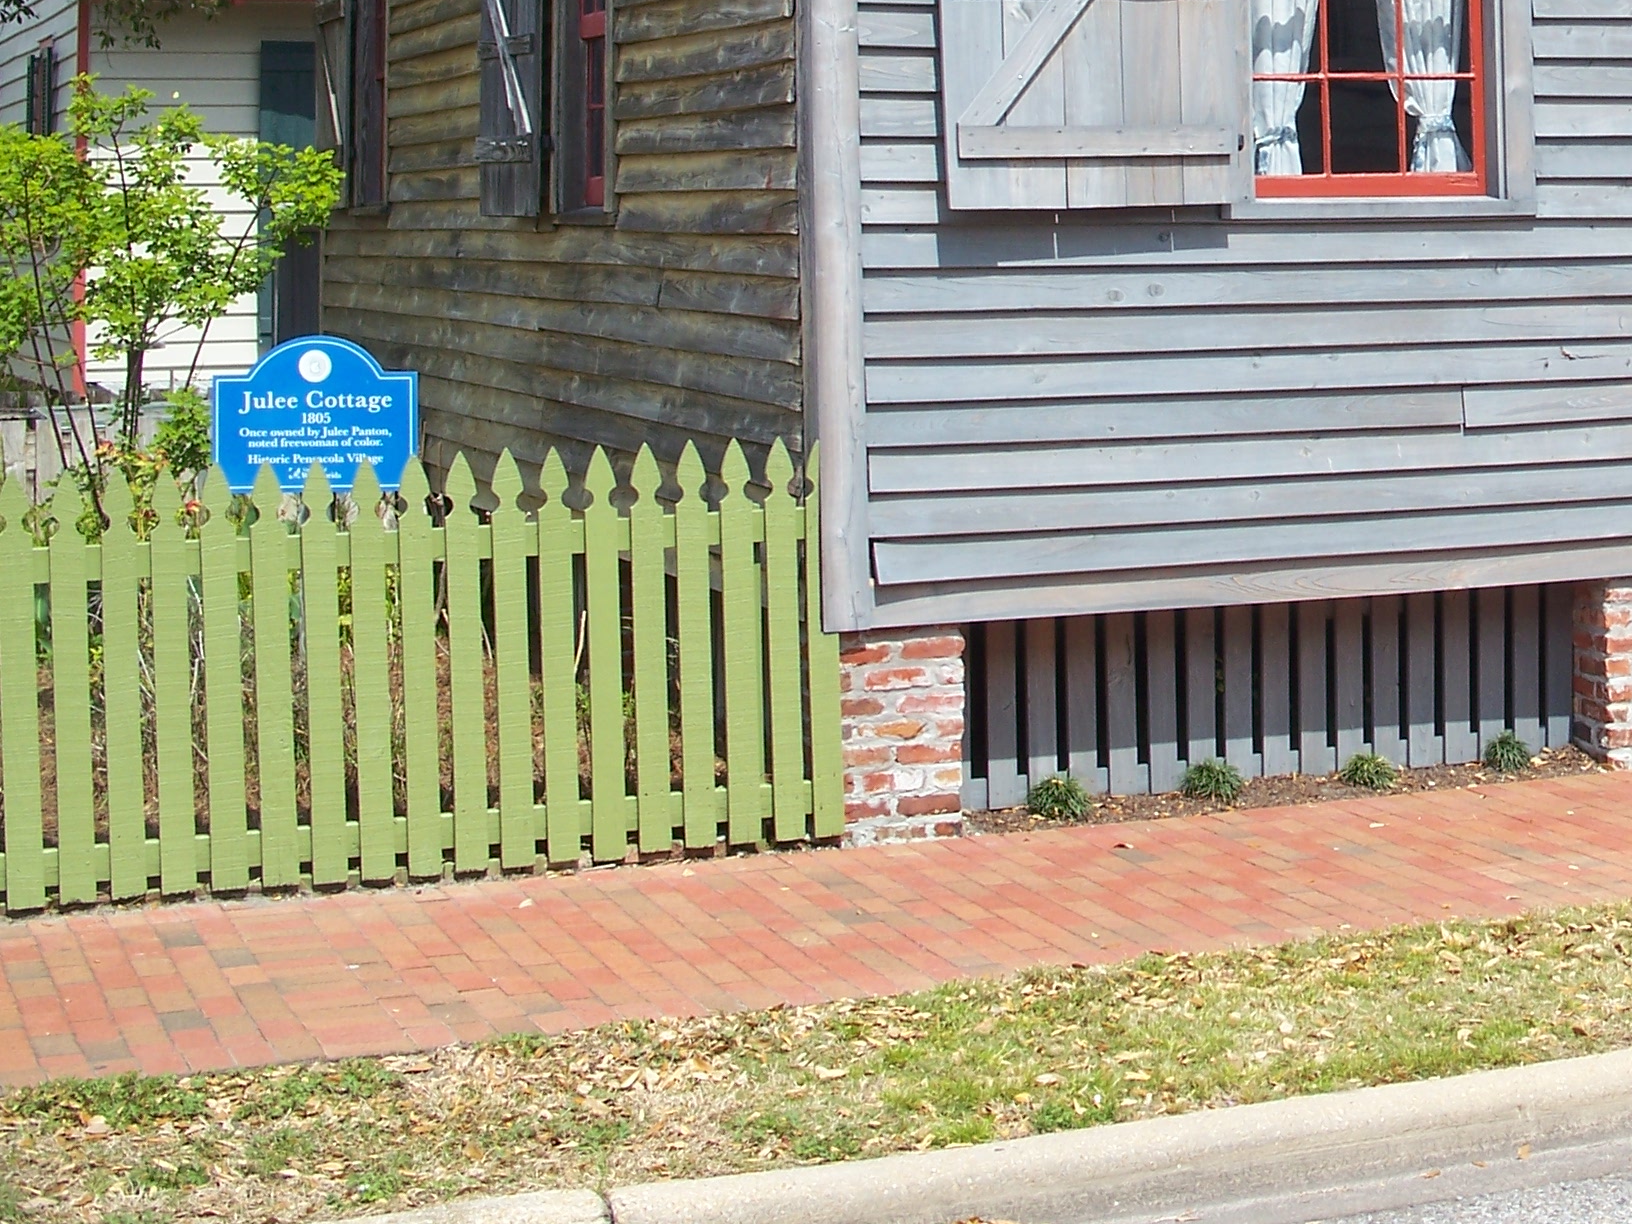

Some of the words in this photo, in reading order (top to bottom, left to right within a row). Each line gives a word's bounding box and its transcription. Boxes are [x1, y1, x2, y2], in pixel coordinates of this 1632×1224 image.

[238, 391, 299, 415] Julee
[305, 390, 393, 413] Cottage
[301, 412, 332, 424] 1805
[239, 427, 267, 437] Once
[270, 426, 305, 437] owned
[307, 426, 321, 439] by
[320, 426, 349, 439] Julee
[351, 426, 393, 438] Panton,
[248, 438, 278, 448] noted
[280, 437, 339, 448] freewoman
[340, 437, 354, 447] of
[353, 437, 384, 447] color.
